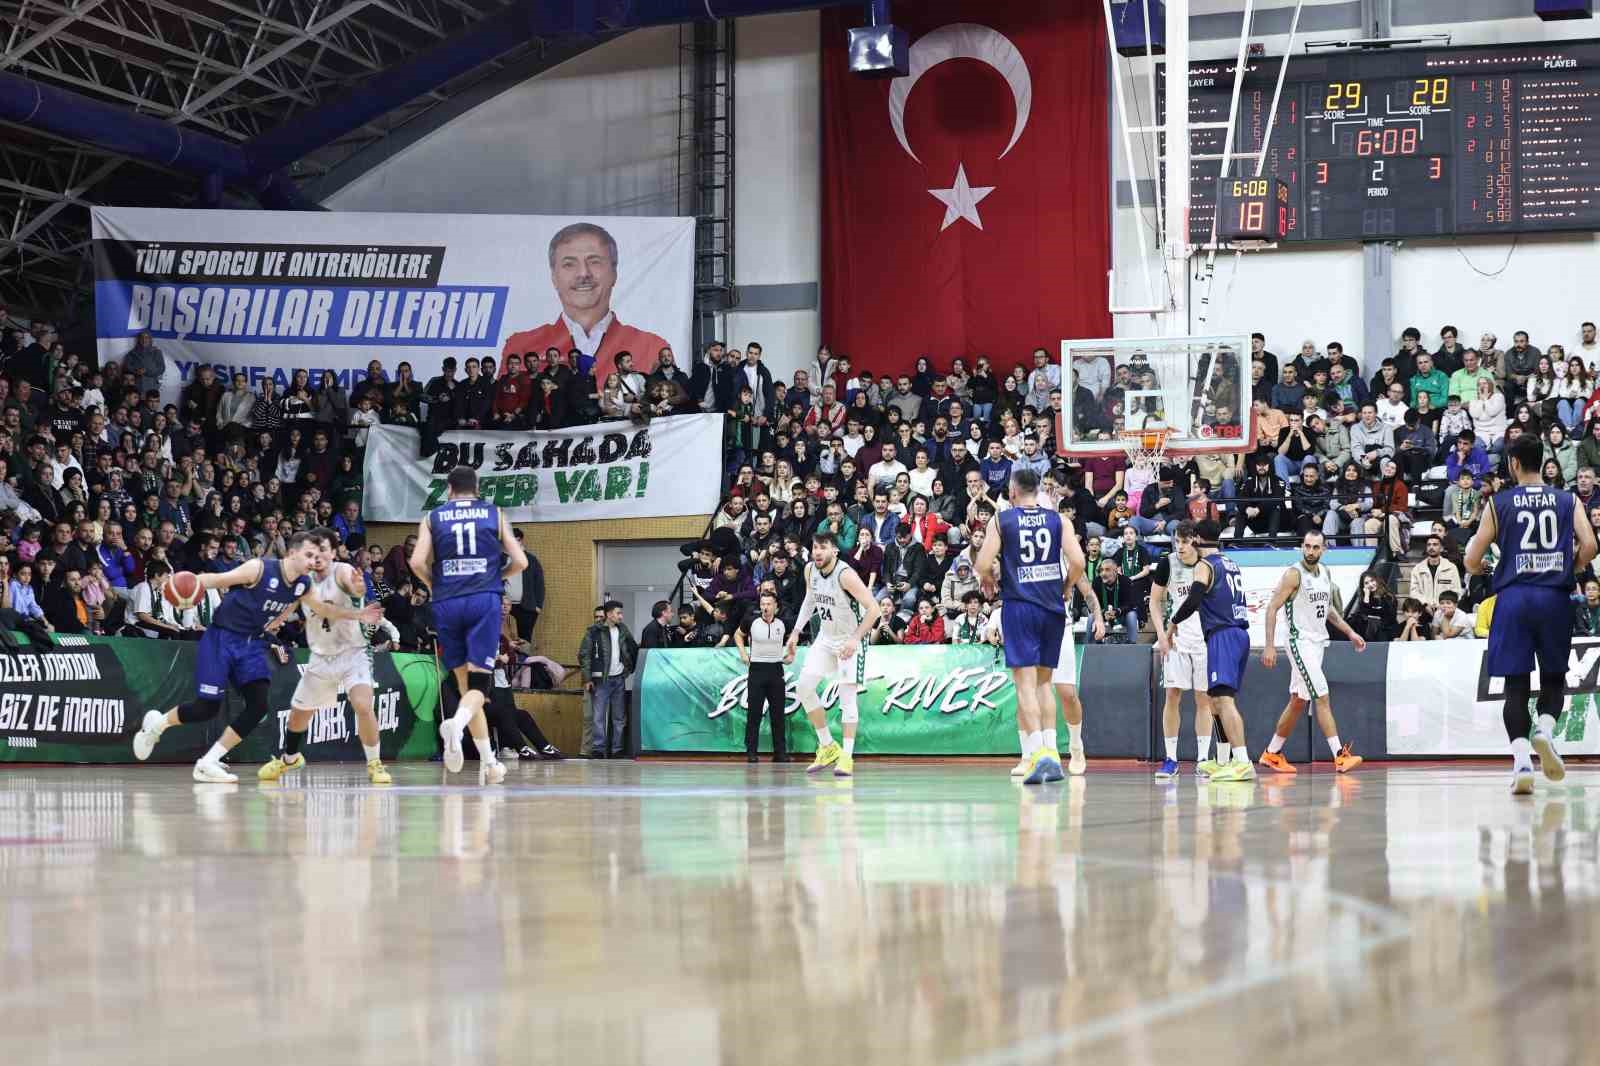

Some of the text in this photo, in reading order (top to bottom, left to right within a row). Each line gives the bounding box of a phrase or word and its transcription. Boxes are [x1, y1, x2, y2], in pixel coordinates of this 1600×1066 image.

[1544, 60, 1577, 69] PLAYER
[1189, 78, 1214, 87] LAYER
[1413, 78, 1448, 105] 28
[1326, 83, 1361, 109] 29
[1324, 110, 1345, 120] SCORE
[1409, 105, 1431, 115] SCORE
[1367, 118, 1384, 127] TIME
[1357, 128, 1416, 156] 6:08
[1316, 162, 1328, 184] 3
[1372, 160, 1384, 181] 2
[1429, 157, 1441, 179] 3
[1232, 180, 1268, 197] 6:08
[1367, 187, 1389, 197] PERIOD
[1239, 202, 1265, 231] 18
[136, 243, 433, 279] TÜM SPORCU VE ANTRENÖRLERE
[128, 284, 334, 341] BAŞARILAR
[432, 429, 652, 474] BU SAHADA
[421, 462, 649, 511] ZFER VAR!
[1513, 492, 1557, 508] GAFFAR
[438, 508, 489, 523] TOLGAHAN
[1017, 513, 1047, 528] MESUT
[451, 521, 478, 556] 11
[1516, 509, 1558, 550] 20
[1019, 527, 1052, 563] 59
[820, 607, 833, 621] 24
[882, 667, 1009, 715] RIVER
[33, 695, 61, 732] DE
